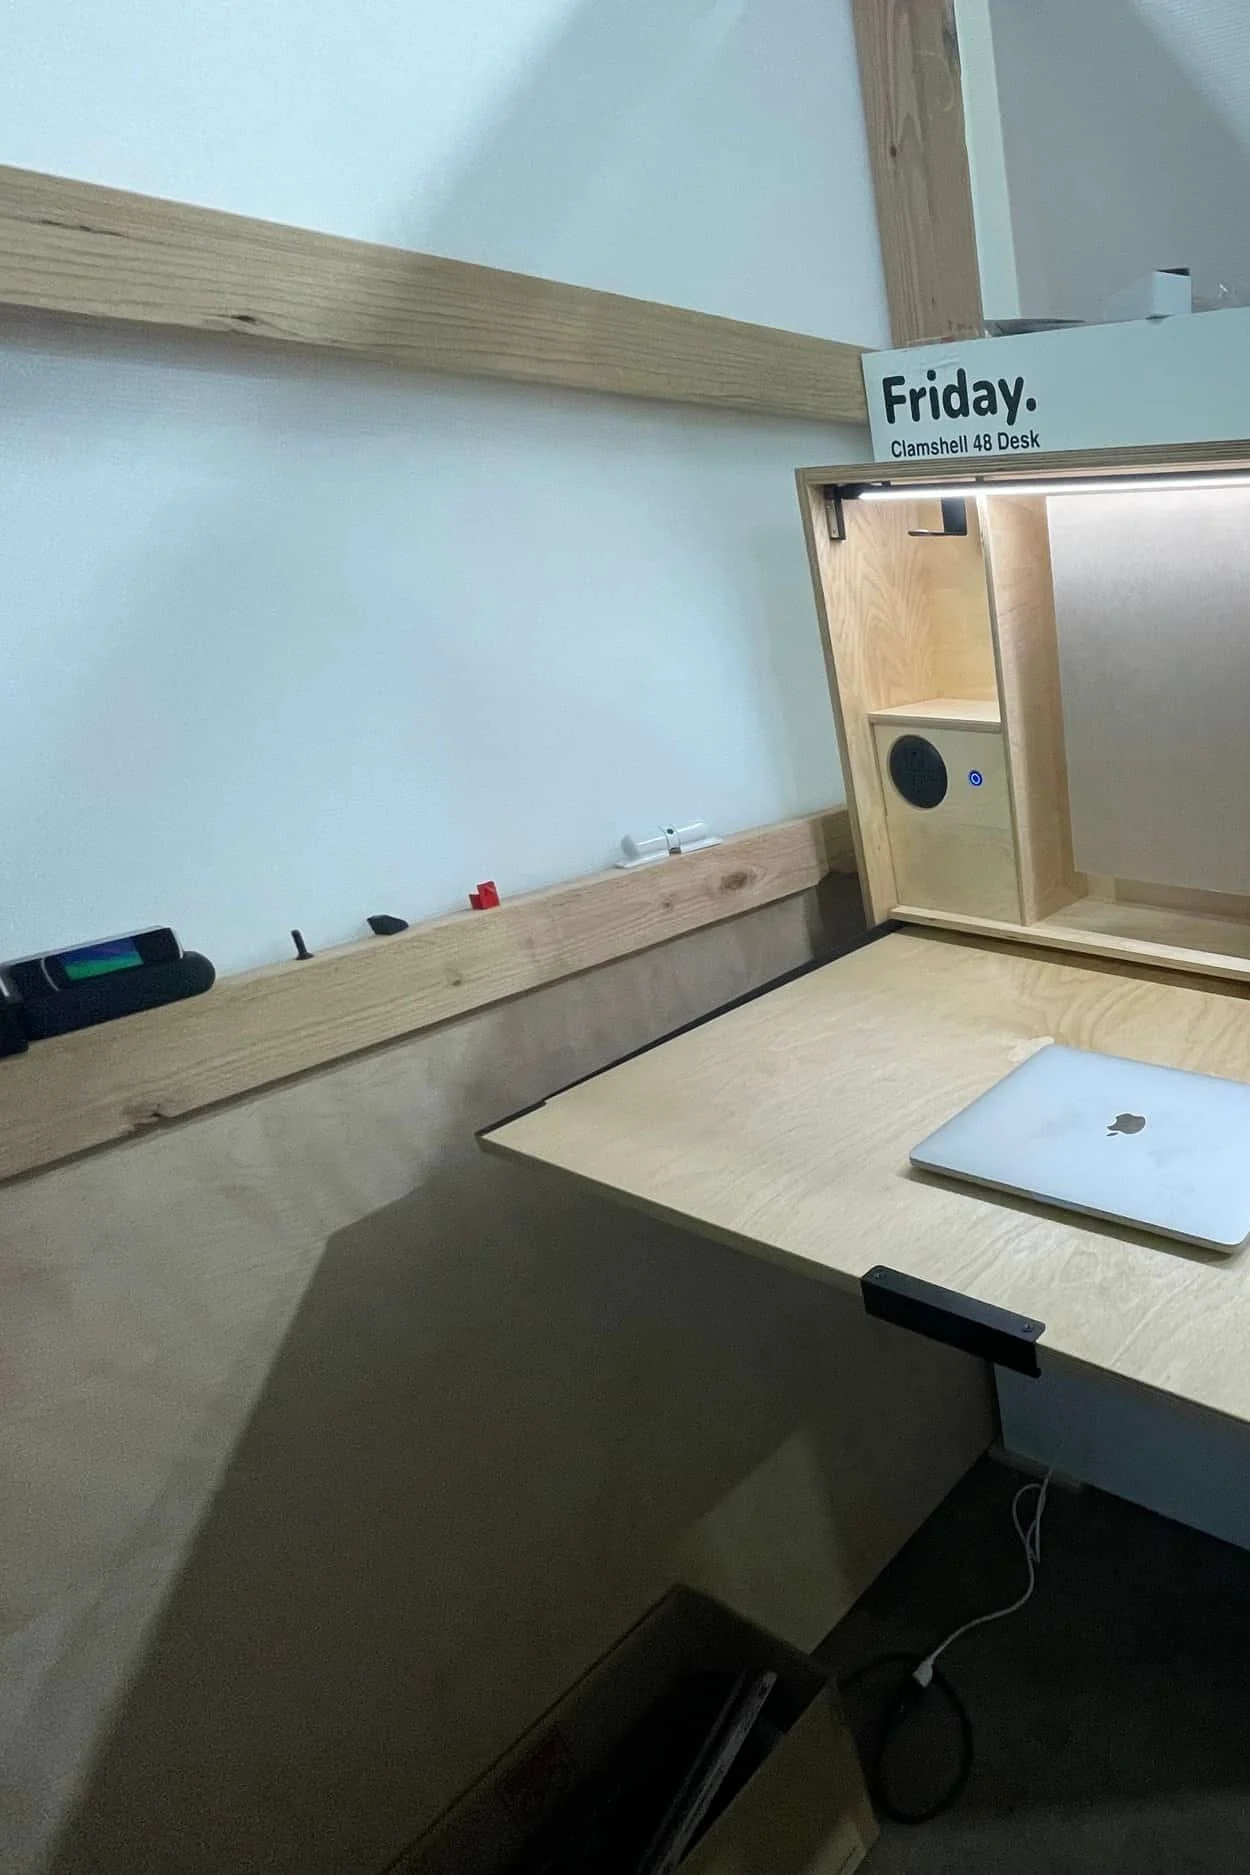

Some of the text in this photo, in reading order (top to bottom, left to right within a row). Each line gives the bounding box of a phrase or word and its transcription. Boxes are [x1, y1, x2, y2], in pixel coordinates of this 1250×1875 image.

[882, 367, 1037, 426] Friday.
[891, 430, 1041, 458] Clamshell 48 Desk
